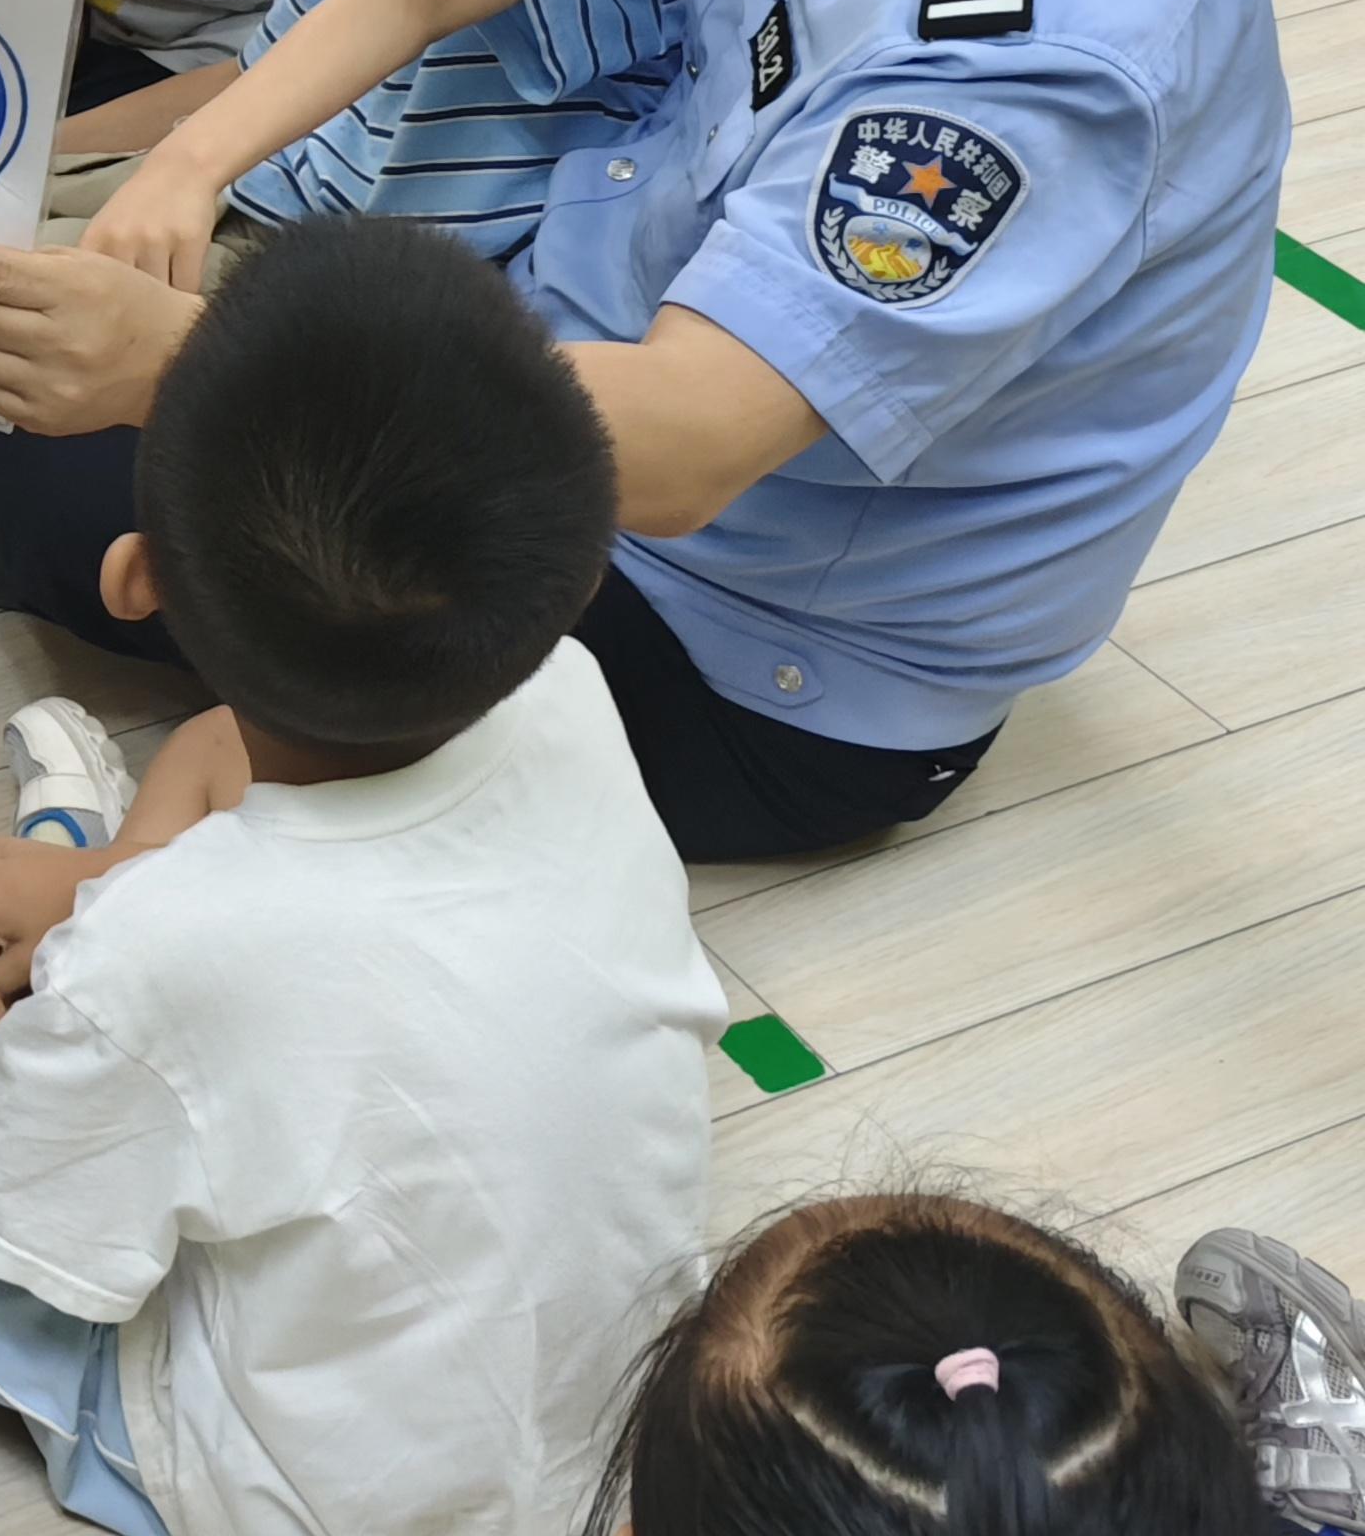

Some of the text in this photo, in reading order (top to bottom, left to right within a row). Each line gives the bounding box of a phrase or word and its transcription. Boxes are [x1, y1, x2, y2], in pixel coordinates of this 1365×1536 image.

[857, 117, 1012, 202] 中华人民共和国
[873, 198, 940, 238] POLICE
